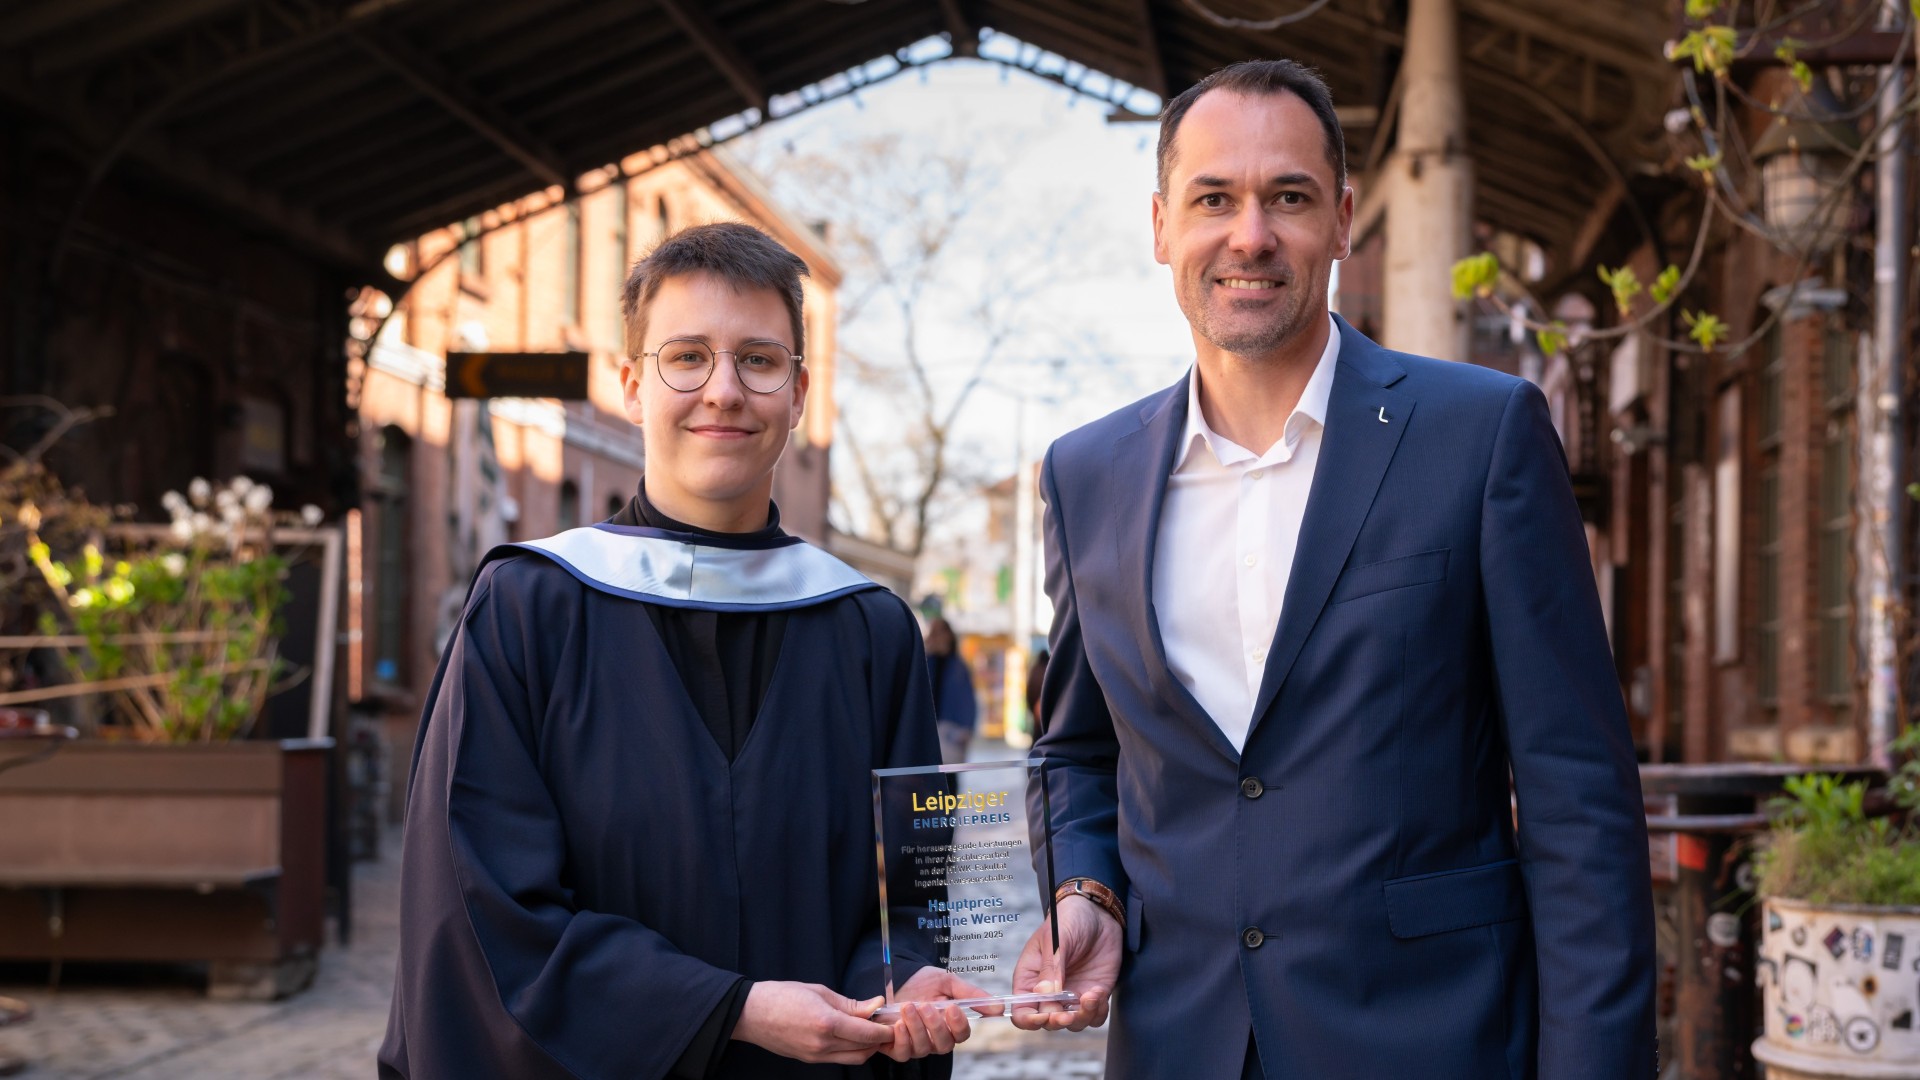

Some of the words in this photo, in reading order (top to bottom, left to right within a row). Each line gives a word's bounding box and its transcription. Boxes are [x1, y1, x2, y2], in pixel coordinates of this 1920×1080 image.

[912, 790, 1008, 815] Leipziger
[913, 813, 1010, 829] ENERGIEPREIS
[901, 845, 915, 854] Für
[978, 839, 1022, 849] Leistungen
[928, 896, 1003, 912] Hauptpreis
[917, 916, 968, 929] Pauline
[971, 912, 1021, 925] Werner
[984, 930, 1004, 939] 2025
[970, 953, 989, 961] durch
[946, 965, 965, 974] Netz
[966, 964, 995, 973] Leipzig
